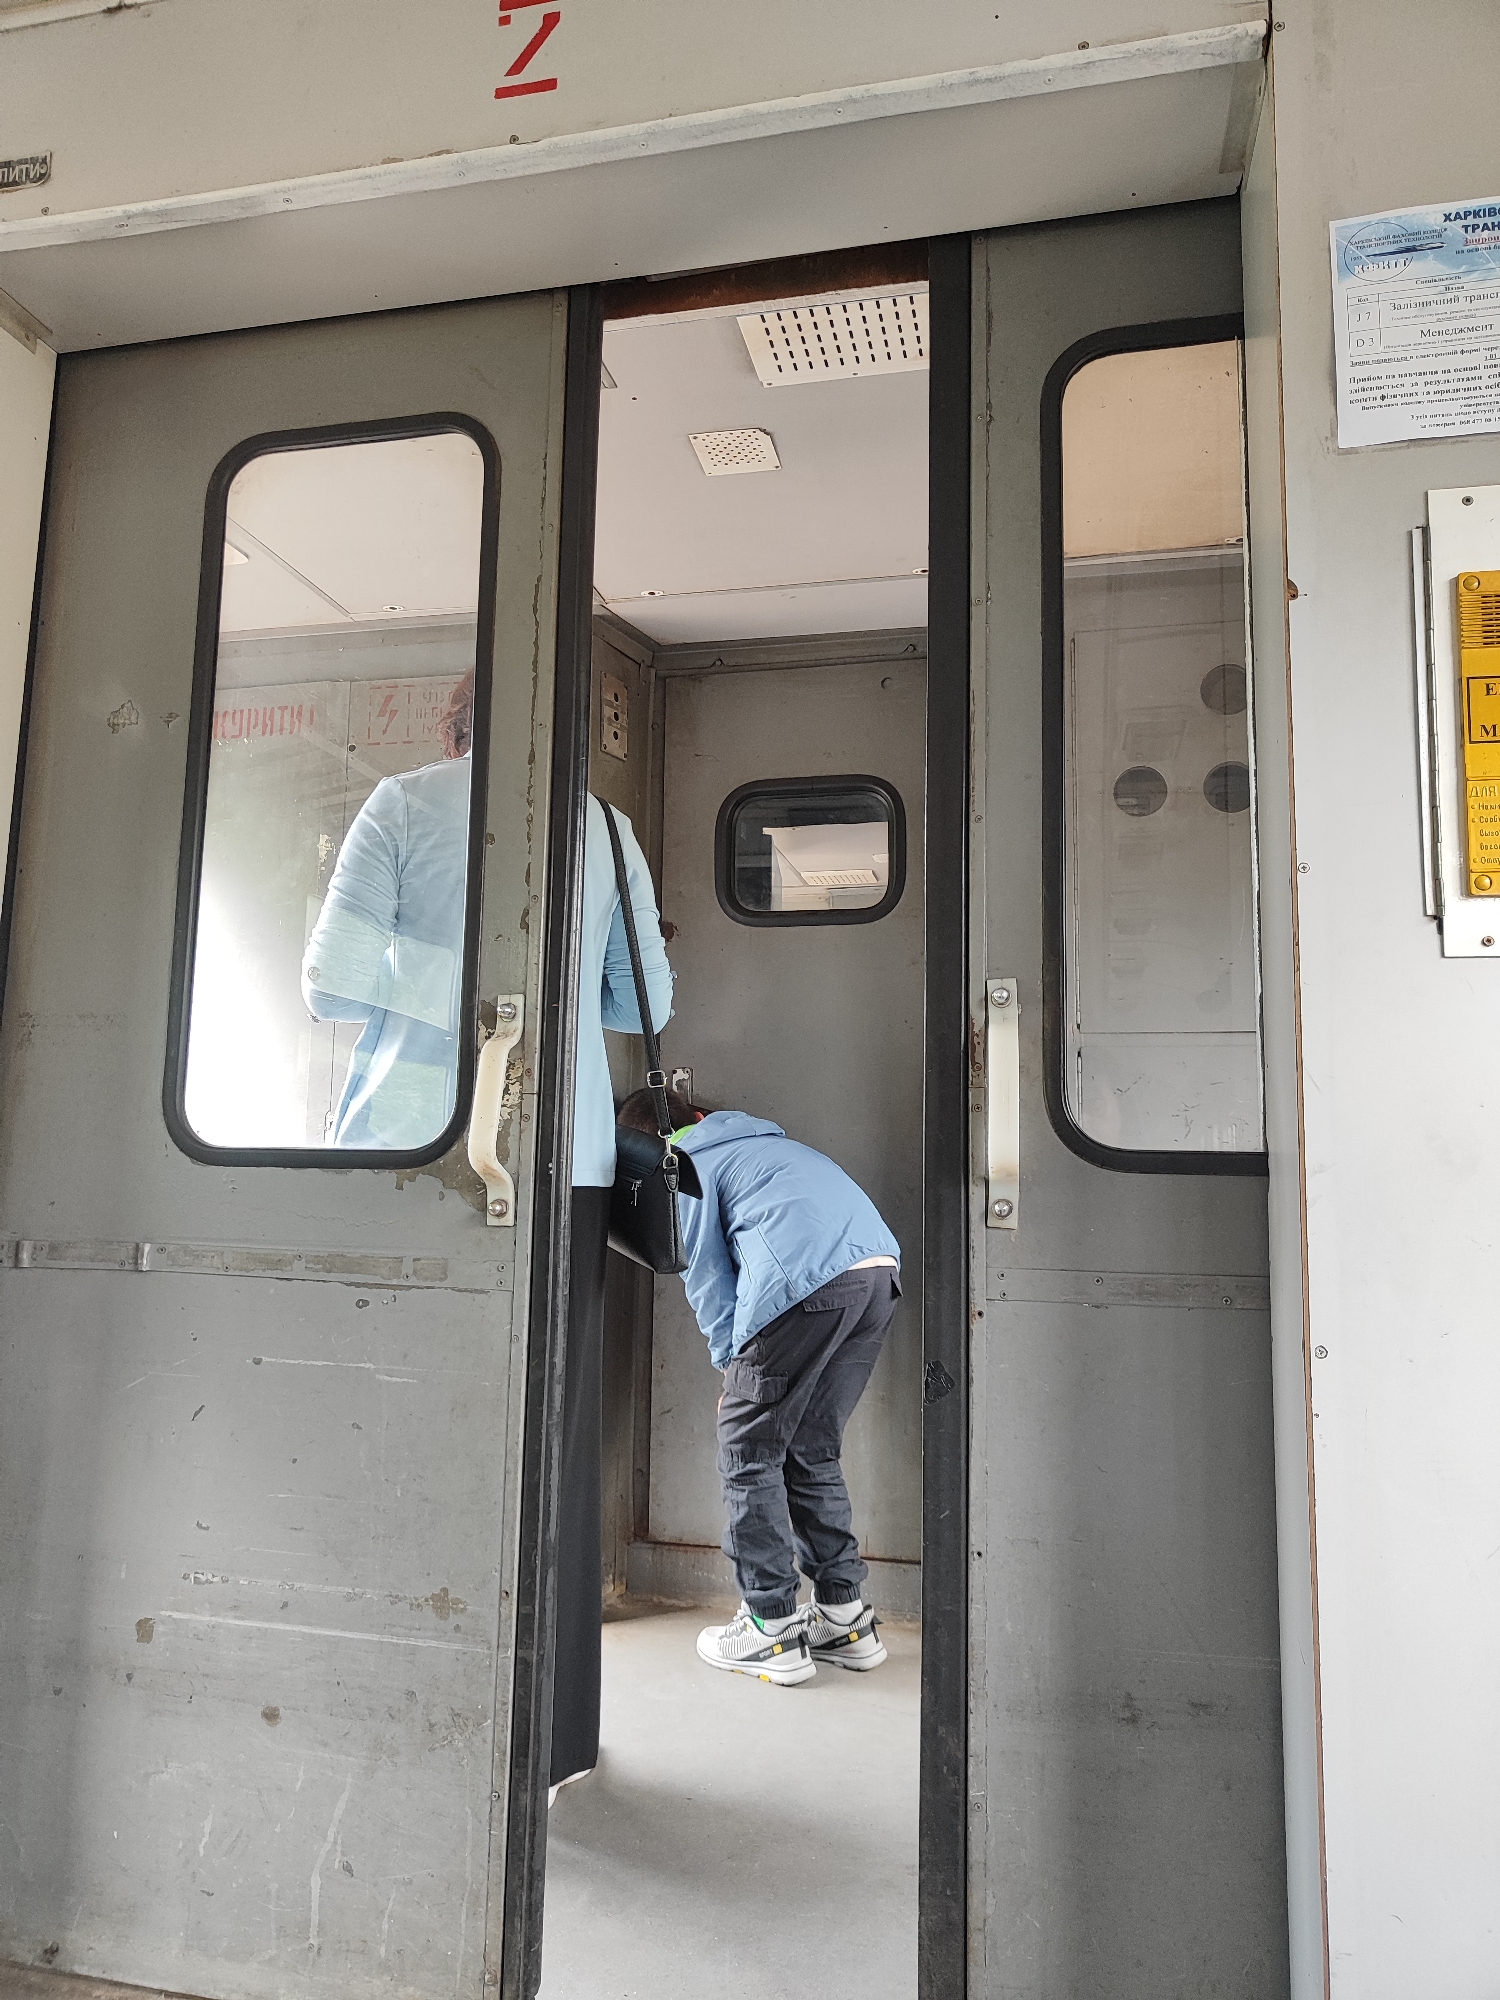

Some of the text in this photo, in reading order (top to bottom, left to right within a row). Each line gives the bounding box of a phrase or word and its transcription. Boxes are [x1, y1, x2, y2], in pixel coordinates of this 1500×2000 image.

[1389, 294, 1461, 311] Залізничний
[1365, 311, 1371, 321] 7
[1420, 322, 1494, 339] Менеджмент
[1368, 337, 1375, 347] 3
[1482, 345, 1500, 353] чере
[1349, 375, 1383, 385] Прийом
[1398, 369, 1439, 379] навчання
[1453, 363, 1481, 373] основі
[1349, 382, 1405, 395] здійснюється
[1424, 375, 1483, 388] результатами
[1349, 395, 1378, 405] кошти
[1379, 391, 1419, 402] фізичних
[1433, 386, 1483, 397] юридичних
[1485, 682, 1500, 697] Е
[1480, 724, 1500, 738] М
[1469, 785, 1497, 798] ДЛЯ
[1480, 815, 1500, 824] Сооб
